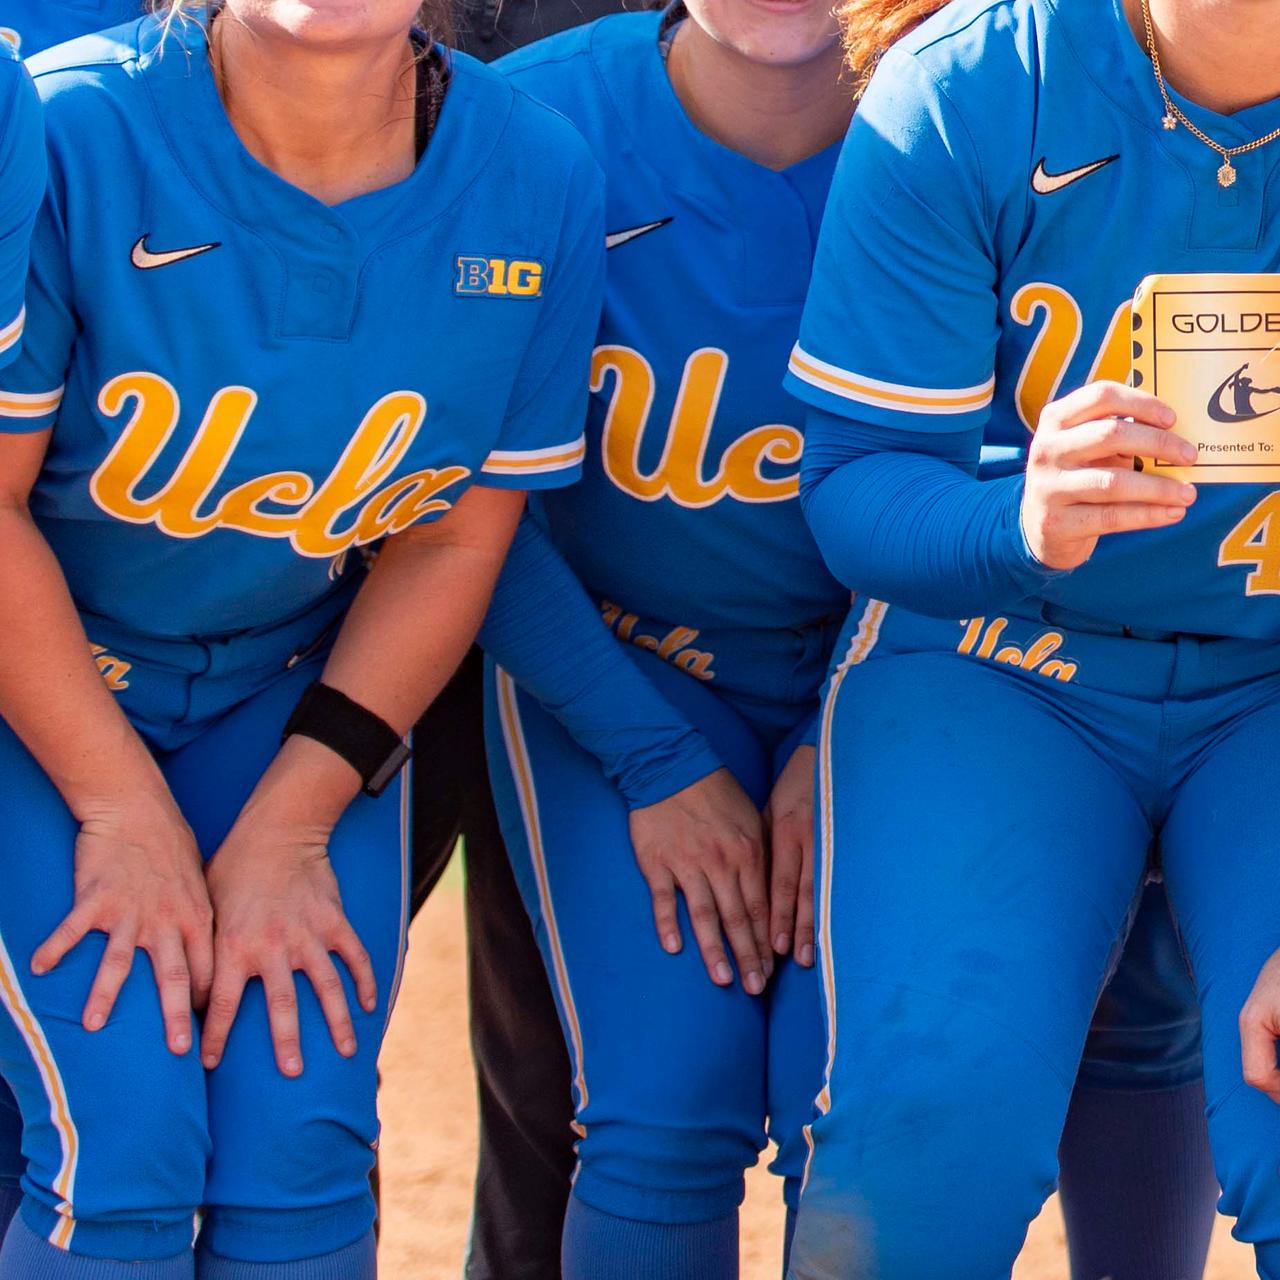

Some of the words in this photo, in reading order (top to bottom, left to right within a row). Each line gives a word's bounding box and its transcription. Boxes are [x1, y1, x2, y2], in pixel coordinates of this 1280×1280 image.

[89, 371, 471, 557] Ucla
[1197, 442, 1254, 452] Presented
[1257, 442, 1274, 452] To:
